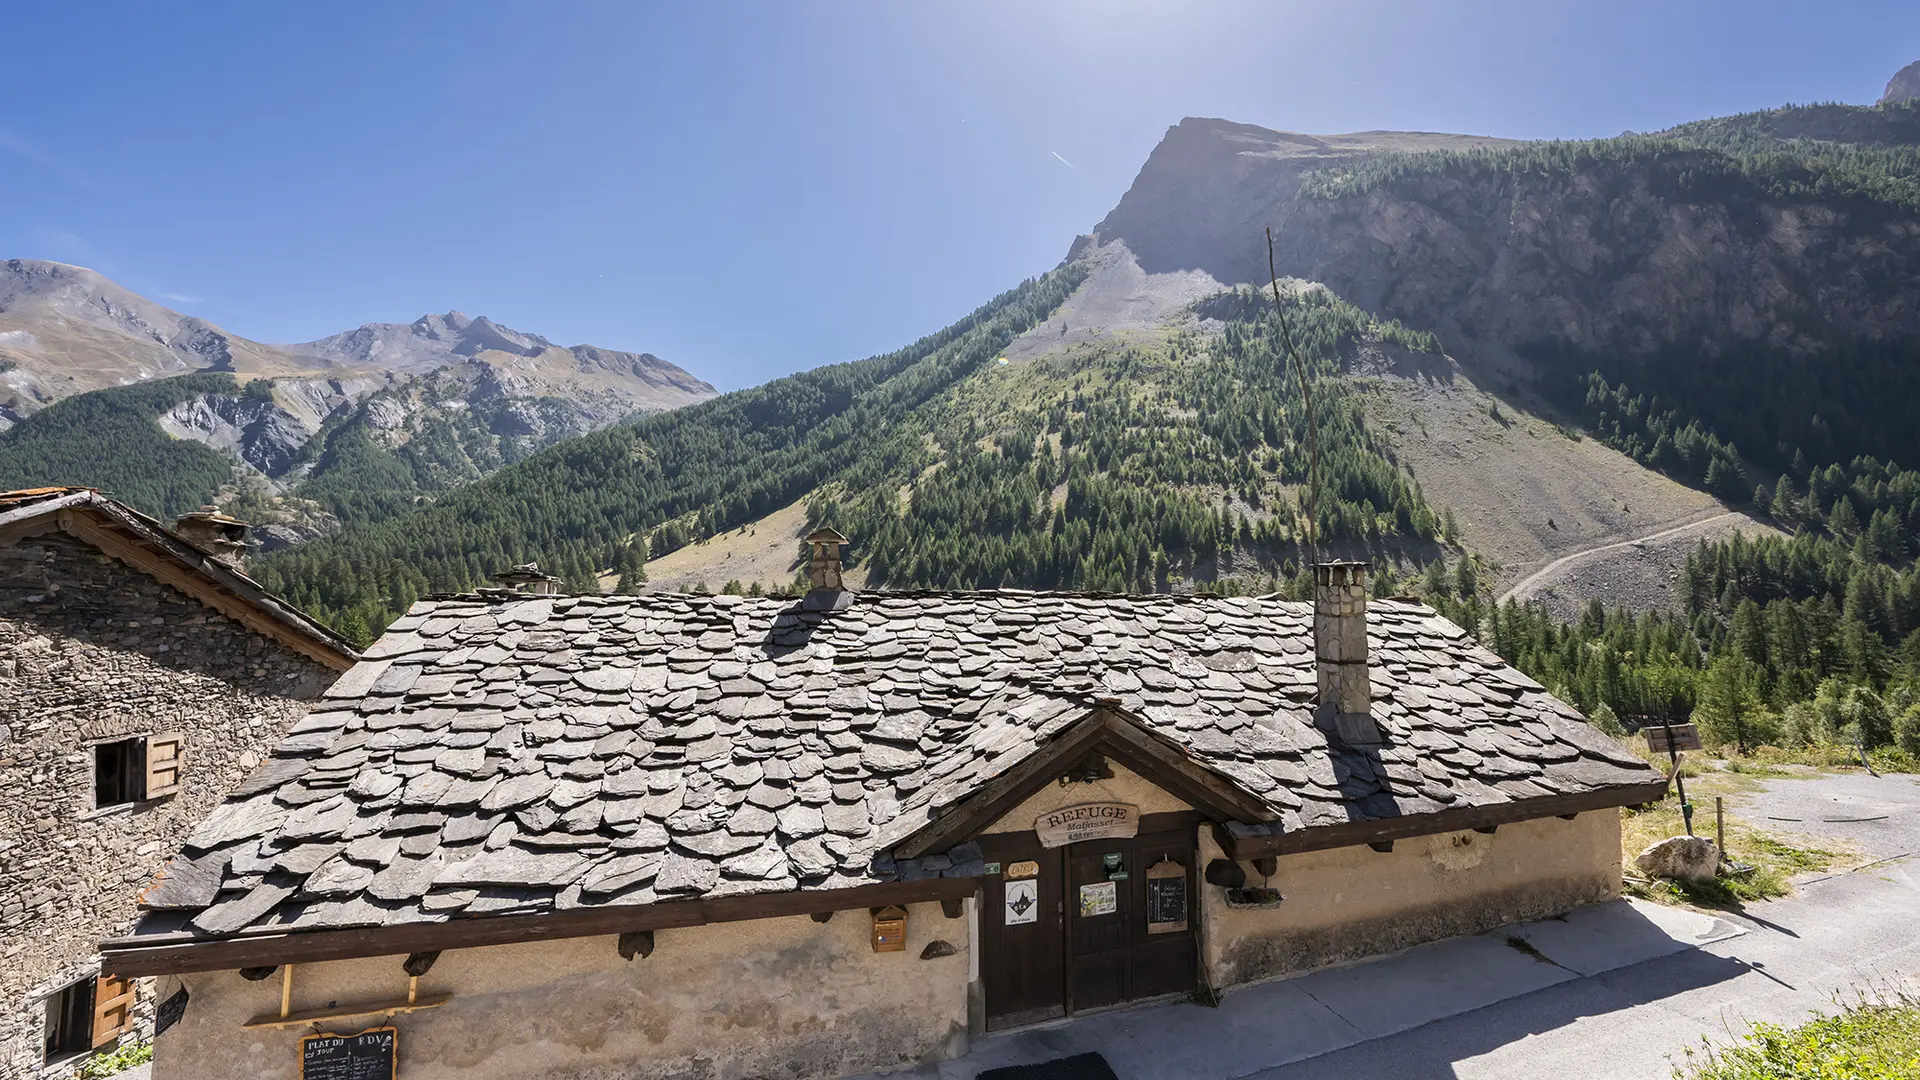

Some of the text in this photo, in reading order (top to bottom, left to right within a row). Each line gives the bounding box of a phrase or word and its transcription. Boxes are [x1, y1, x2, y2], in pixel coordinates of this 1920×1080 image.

[1047, 806, 1127, 828] REFUGE
[1066, 819, 1114, 832] Maljasset
[308, 1038, 344, 1050] PLAT DU
